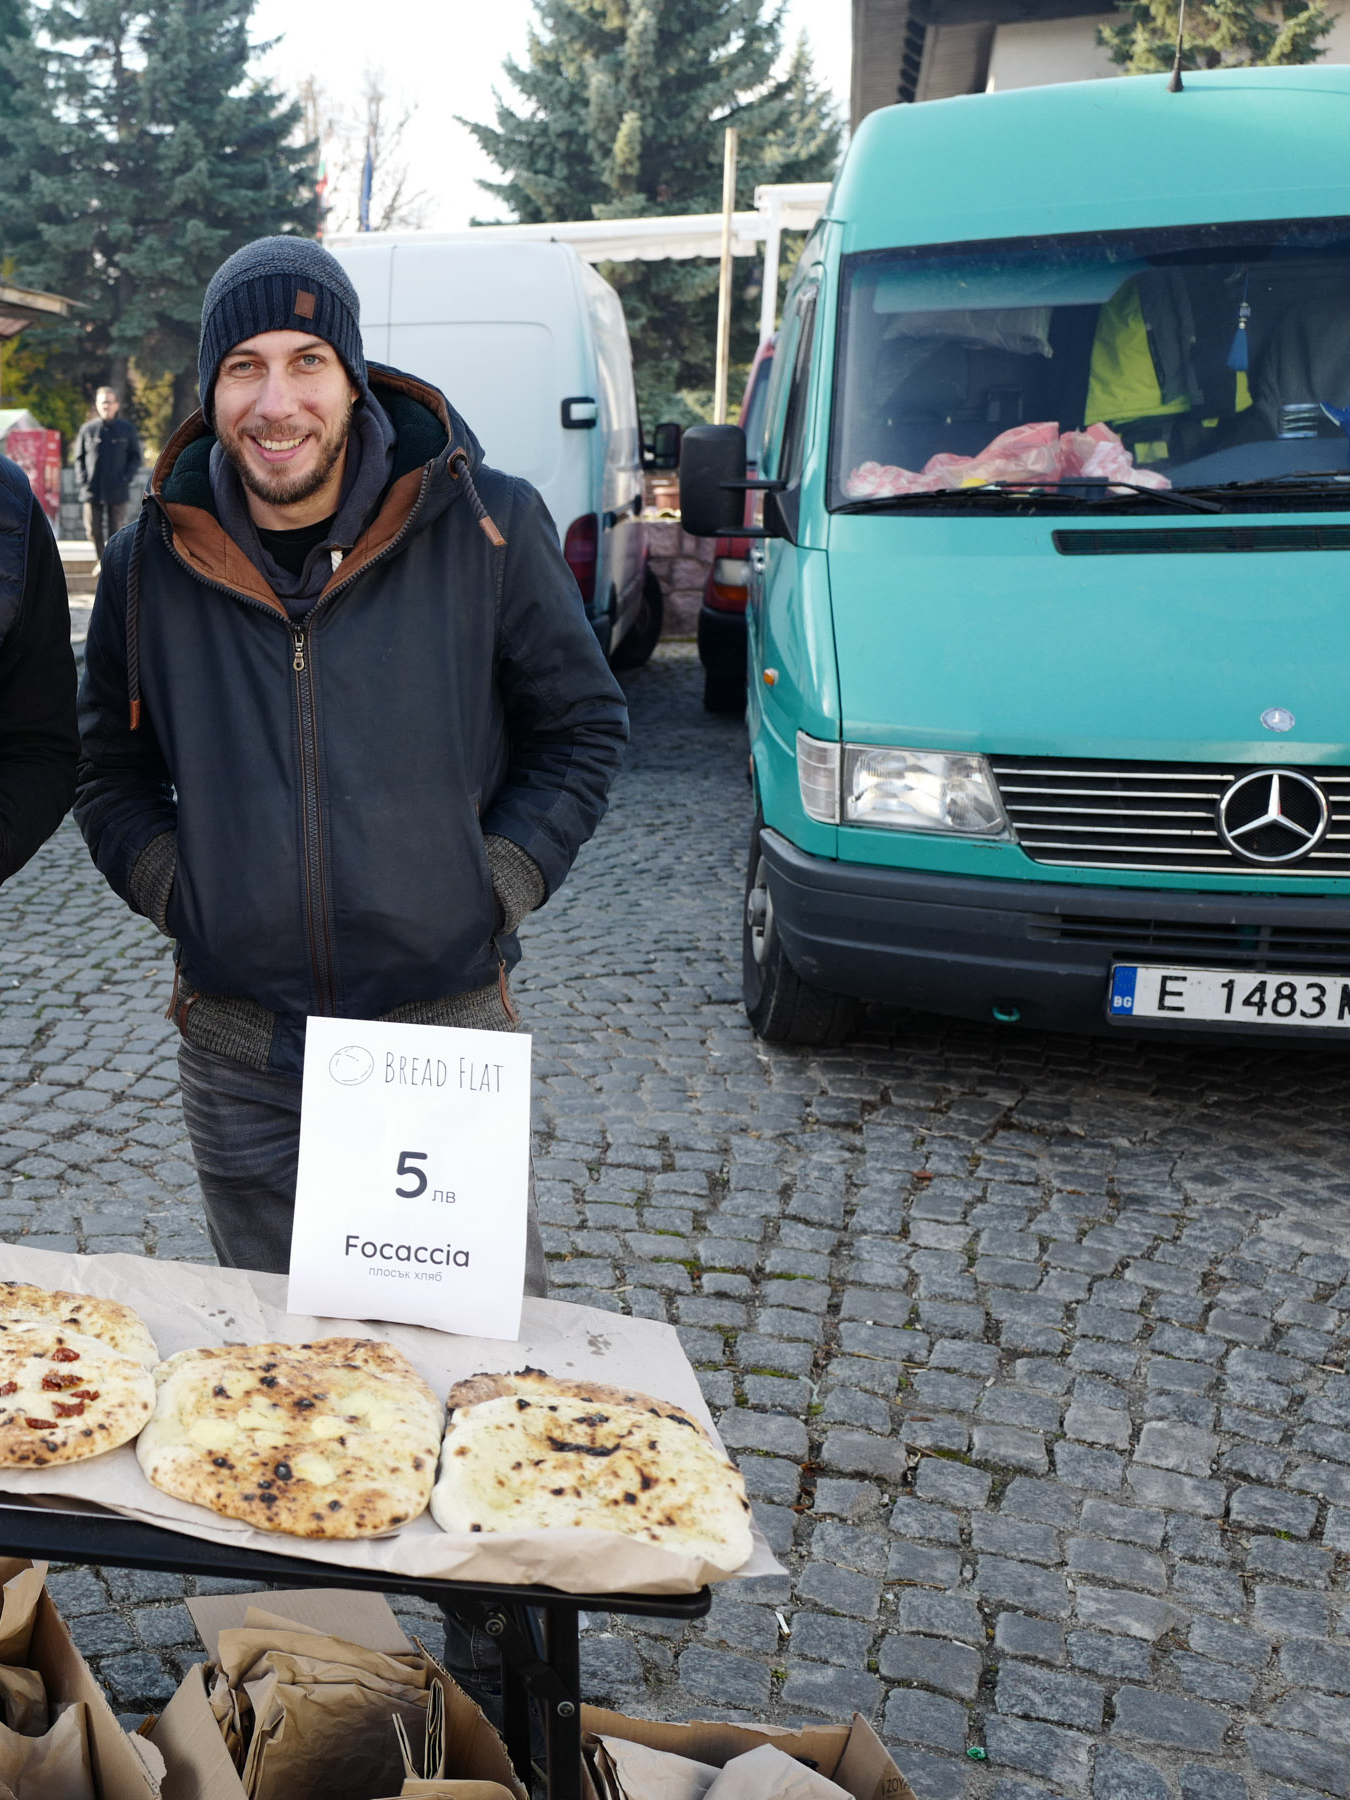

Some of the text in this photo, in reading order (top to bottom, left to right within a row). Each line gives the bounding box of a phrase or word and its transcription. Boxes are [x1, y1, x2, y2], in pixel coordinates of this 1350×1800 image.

[1113, 995, 1132, 1008] BG
[1157, 975, 1188, 1012] E
[385, 1051, 505, 1093] BREAD FLAT
[345, 1234, 470, 1268] Focaccia
[368, 1267, 443, 1282] плосък хляб
